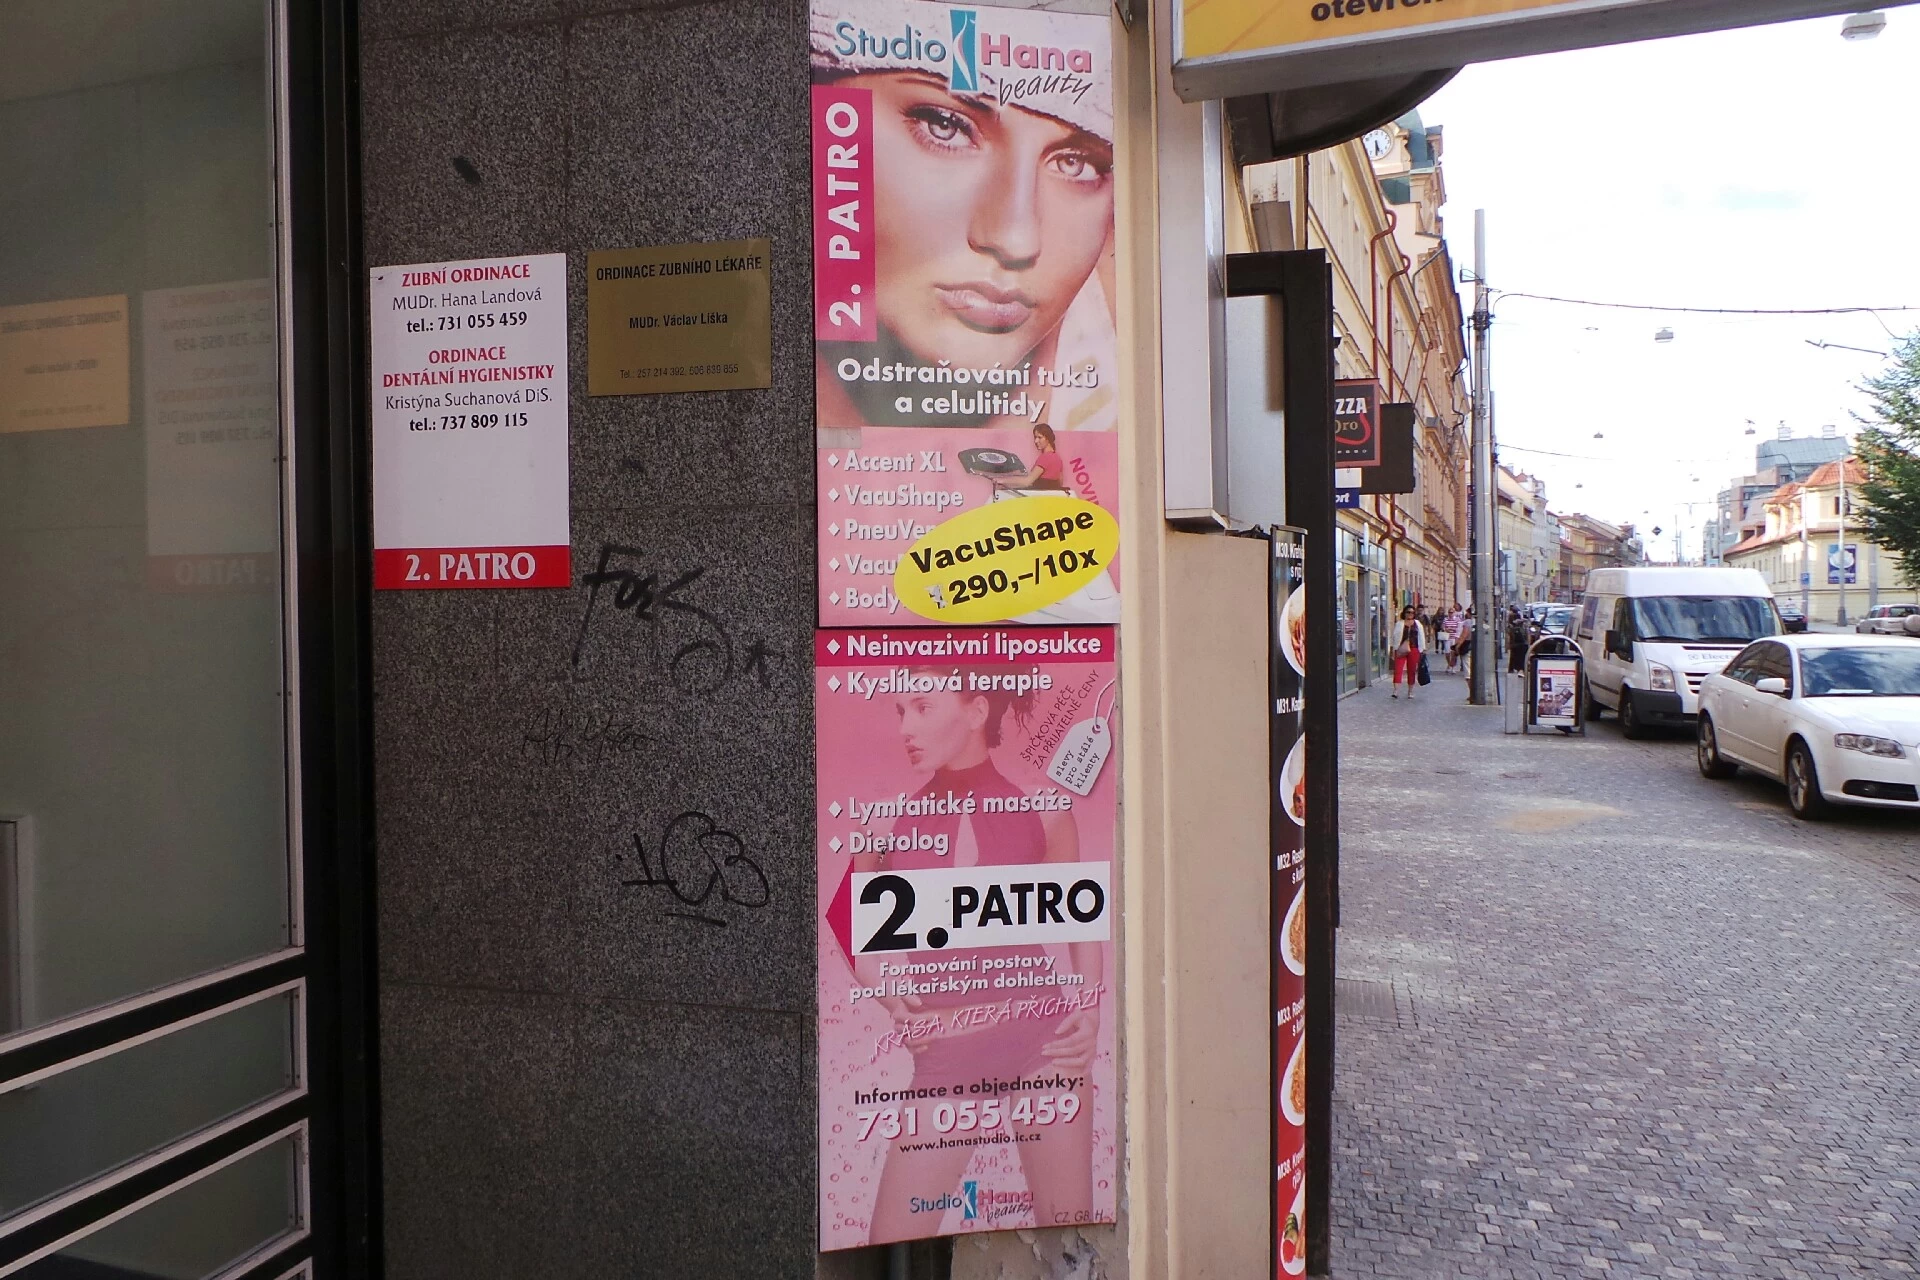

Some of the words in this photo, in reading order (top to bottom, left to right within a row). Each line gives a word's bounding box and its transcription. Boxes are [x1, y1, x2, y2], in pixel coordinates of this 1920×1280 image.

[1311, 0, 1443, 21] otev
[834, 21, 947, 63] Studio
[980, 32, 1093, 74] Hana
[1000, 73, 1093, 106] beauty
[825, 101, 861, 260] PATRO
[402, 266, 447, 287] ZUBNÍ
[451, 264, 531, 284] ORDINACE
[596, 264, 656, 281] ORDINACE
[659, 258, 712, 276] ZUBNÍHO
[715, 254, 762, 272] LÉKAŘE
[392, 294, 437, 311] MUDr.
[441, 292, 477, 308] Hana
[481, 287, 542, 304] Landová
[828, 283, 861, 327] 2.
[406, 318, 434, 333] tel.:
[438, 315, 462, 331] 731
[467, 313, 495, 329] 055
[499, 311, 528, 327] 459
[629, 316, 660, 329] MUDr.
[663, 313, 697, 327] Václav
[700, 311, 728, 325] Liška
[428, 346, 507, 364] ORDINACE
[383, 367, 454, 388] DENTÁLNÍ
[458, 365, 555, 384] HYGIENISTKY
[837, 358, 1030, 385] Odstraňování
[1037, 364, 1099, 388] tuků
[385, 394, 441, 412] Kristýna
[444, 391, 521, 407] Suchanová
[525, 388, 552, 403] DiS.
[894, 395, 913, 413] a
[921, 390, 1045, 422] celulitidy
[409, 417, 436, 432] tel.:
[440, 415, 466, 430] 737
[470, 414, 498, 429] 809
[504, 412, 528, 427] 115
[843, 449, 914, 472] Accent
[919, 450, 946, 472] XL
[844, 483, 964, 513] VacuShape
[910, 511, 1094, 574] VacuShape
[405, 553, 430, 581] 2.
[439, 551, 536, 580] PATRO
[844, 553, 905, 575] Vacu
[847, 632, 989, 658] Neinvazivní
[995, 631, 1102, 660] liposukce
[847, 667, 963, 701] Kyslíková
[969, 667, 1053, 696] terapie
[1020, 710, 1058, 762] ŠPIČKOVÁ
[1054, 684, 1075, 711] PÉČE
[1033, 754, 1047, 770] ZA
[1042, 698, 1082, 754] PŘIJATELNÉ
[1077, 669, 1100, 699] CENY
[1055, 750, 1074, 777] slevy
[1065, 766, 1077, 784] pro
[1076, 736, 1094, 764] stálé
[1074, 752, 1100, 789] klienty
[848, 790, 976, 824] Lymfatické
[983, 788, 1072, 814] masáže
[849, 828, 949, 856] Dietolog
[859, 874, 949, 953] 2.
[952, 878, 1105, 929] PATRO
[879, 955, 977, 977] Formování
[982, 954, 1056, 974] postavy
[850, 981, 886, 1004] pod
[892, 975, 989, 997] lékařským
[993, 971, 1085, 989] dohledem
[951, 998, 1012, 1030] KTERÁ
[854, 1086, 947, 1105] Informace
[953, 1083, 964, 1095] a
[969, 1074, 1085, 1098] objednávky:
[856, 1106, 918, 1142] 731
[933, 1099, 1002, 1134] 055
[1011, 1093, 1081, 1128] 459
[899, 1132, 1041, 1153] www.hanastudio.ic.cz
[910, 1193, 963, 1214] Studio
[978, 1189, 1034, 1205] Hana
[987, 1203, 1034, 1223] beauty
